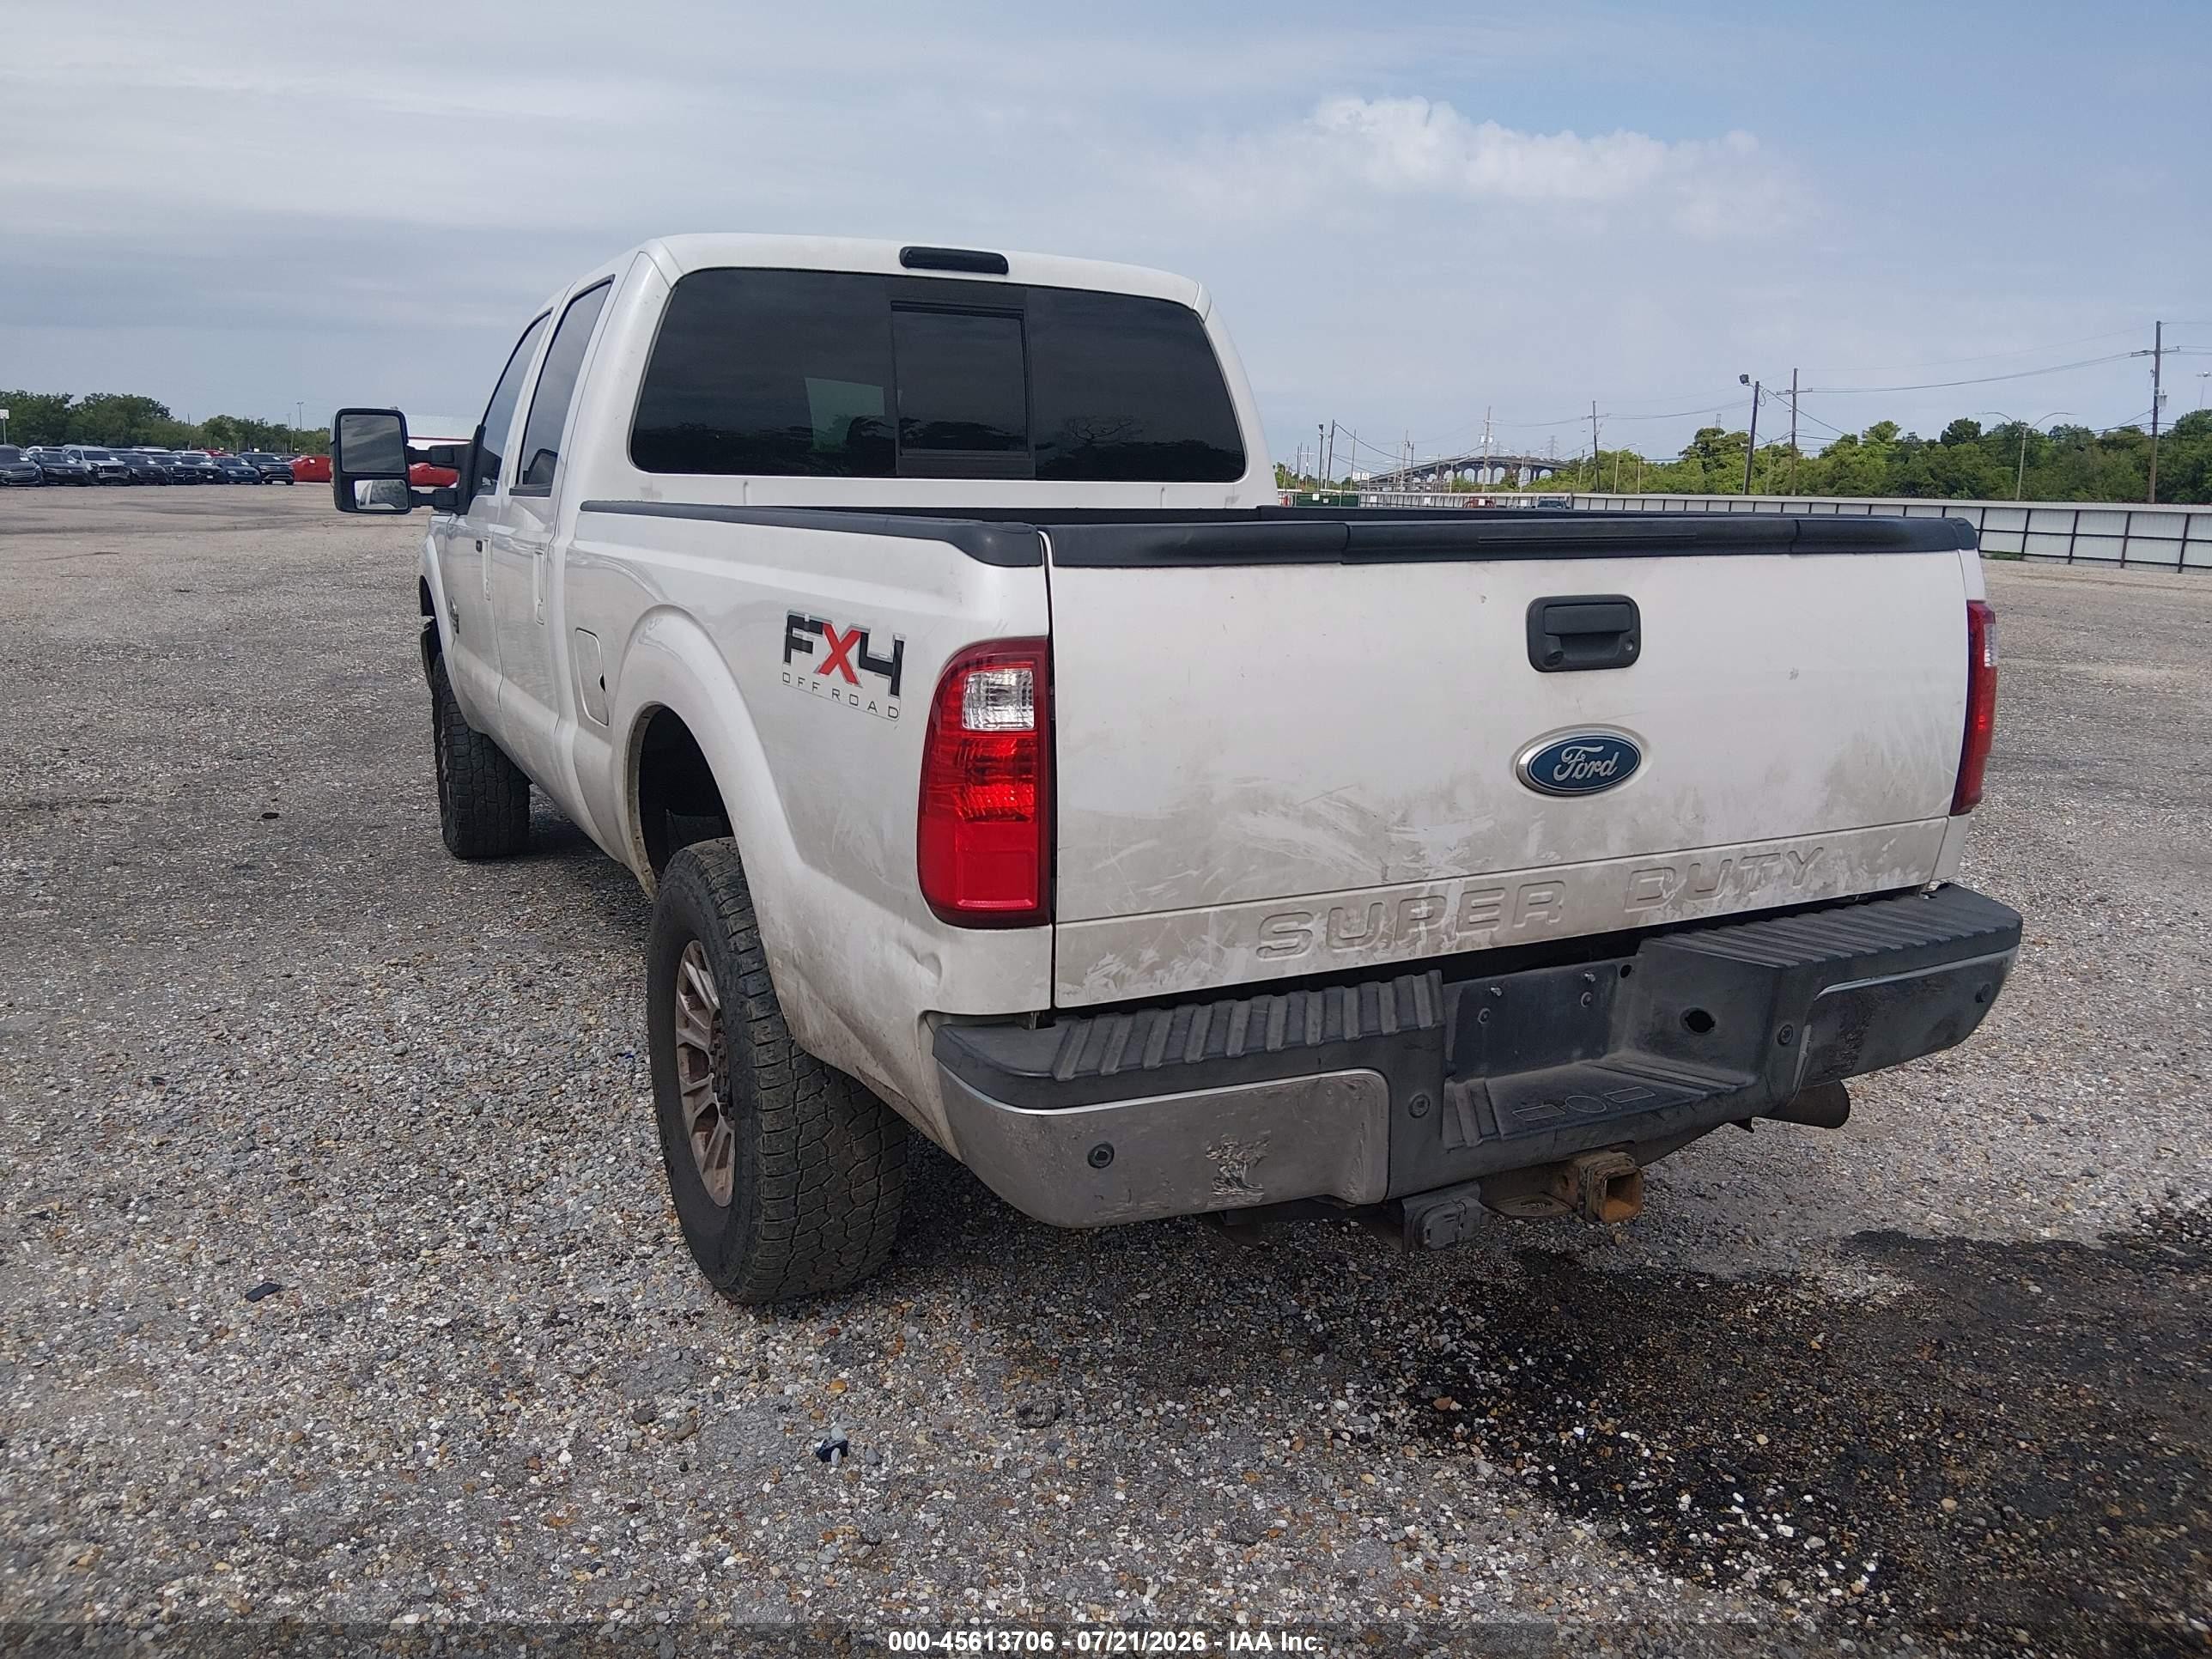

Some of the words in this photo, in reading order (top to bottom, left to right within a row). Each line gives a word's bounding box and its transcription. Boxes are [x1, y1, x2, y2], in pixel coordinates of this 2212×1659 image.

[783, 611, 906, 697] FX4
[1553, 745, 1620, 781] Ford
[1256, 880, 1567, 963] SUPER
[1624, 847, 1824, 913] DUTY
